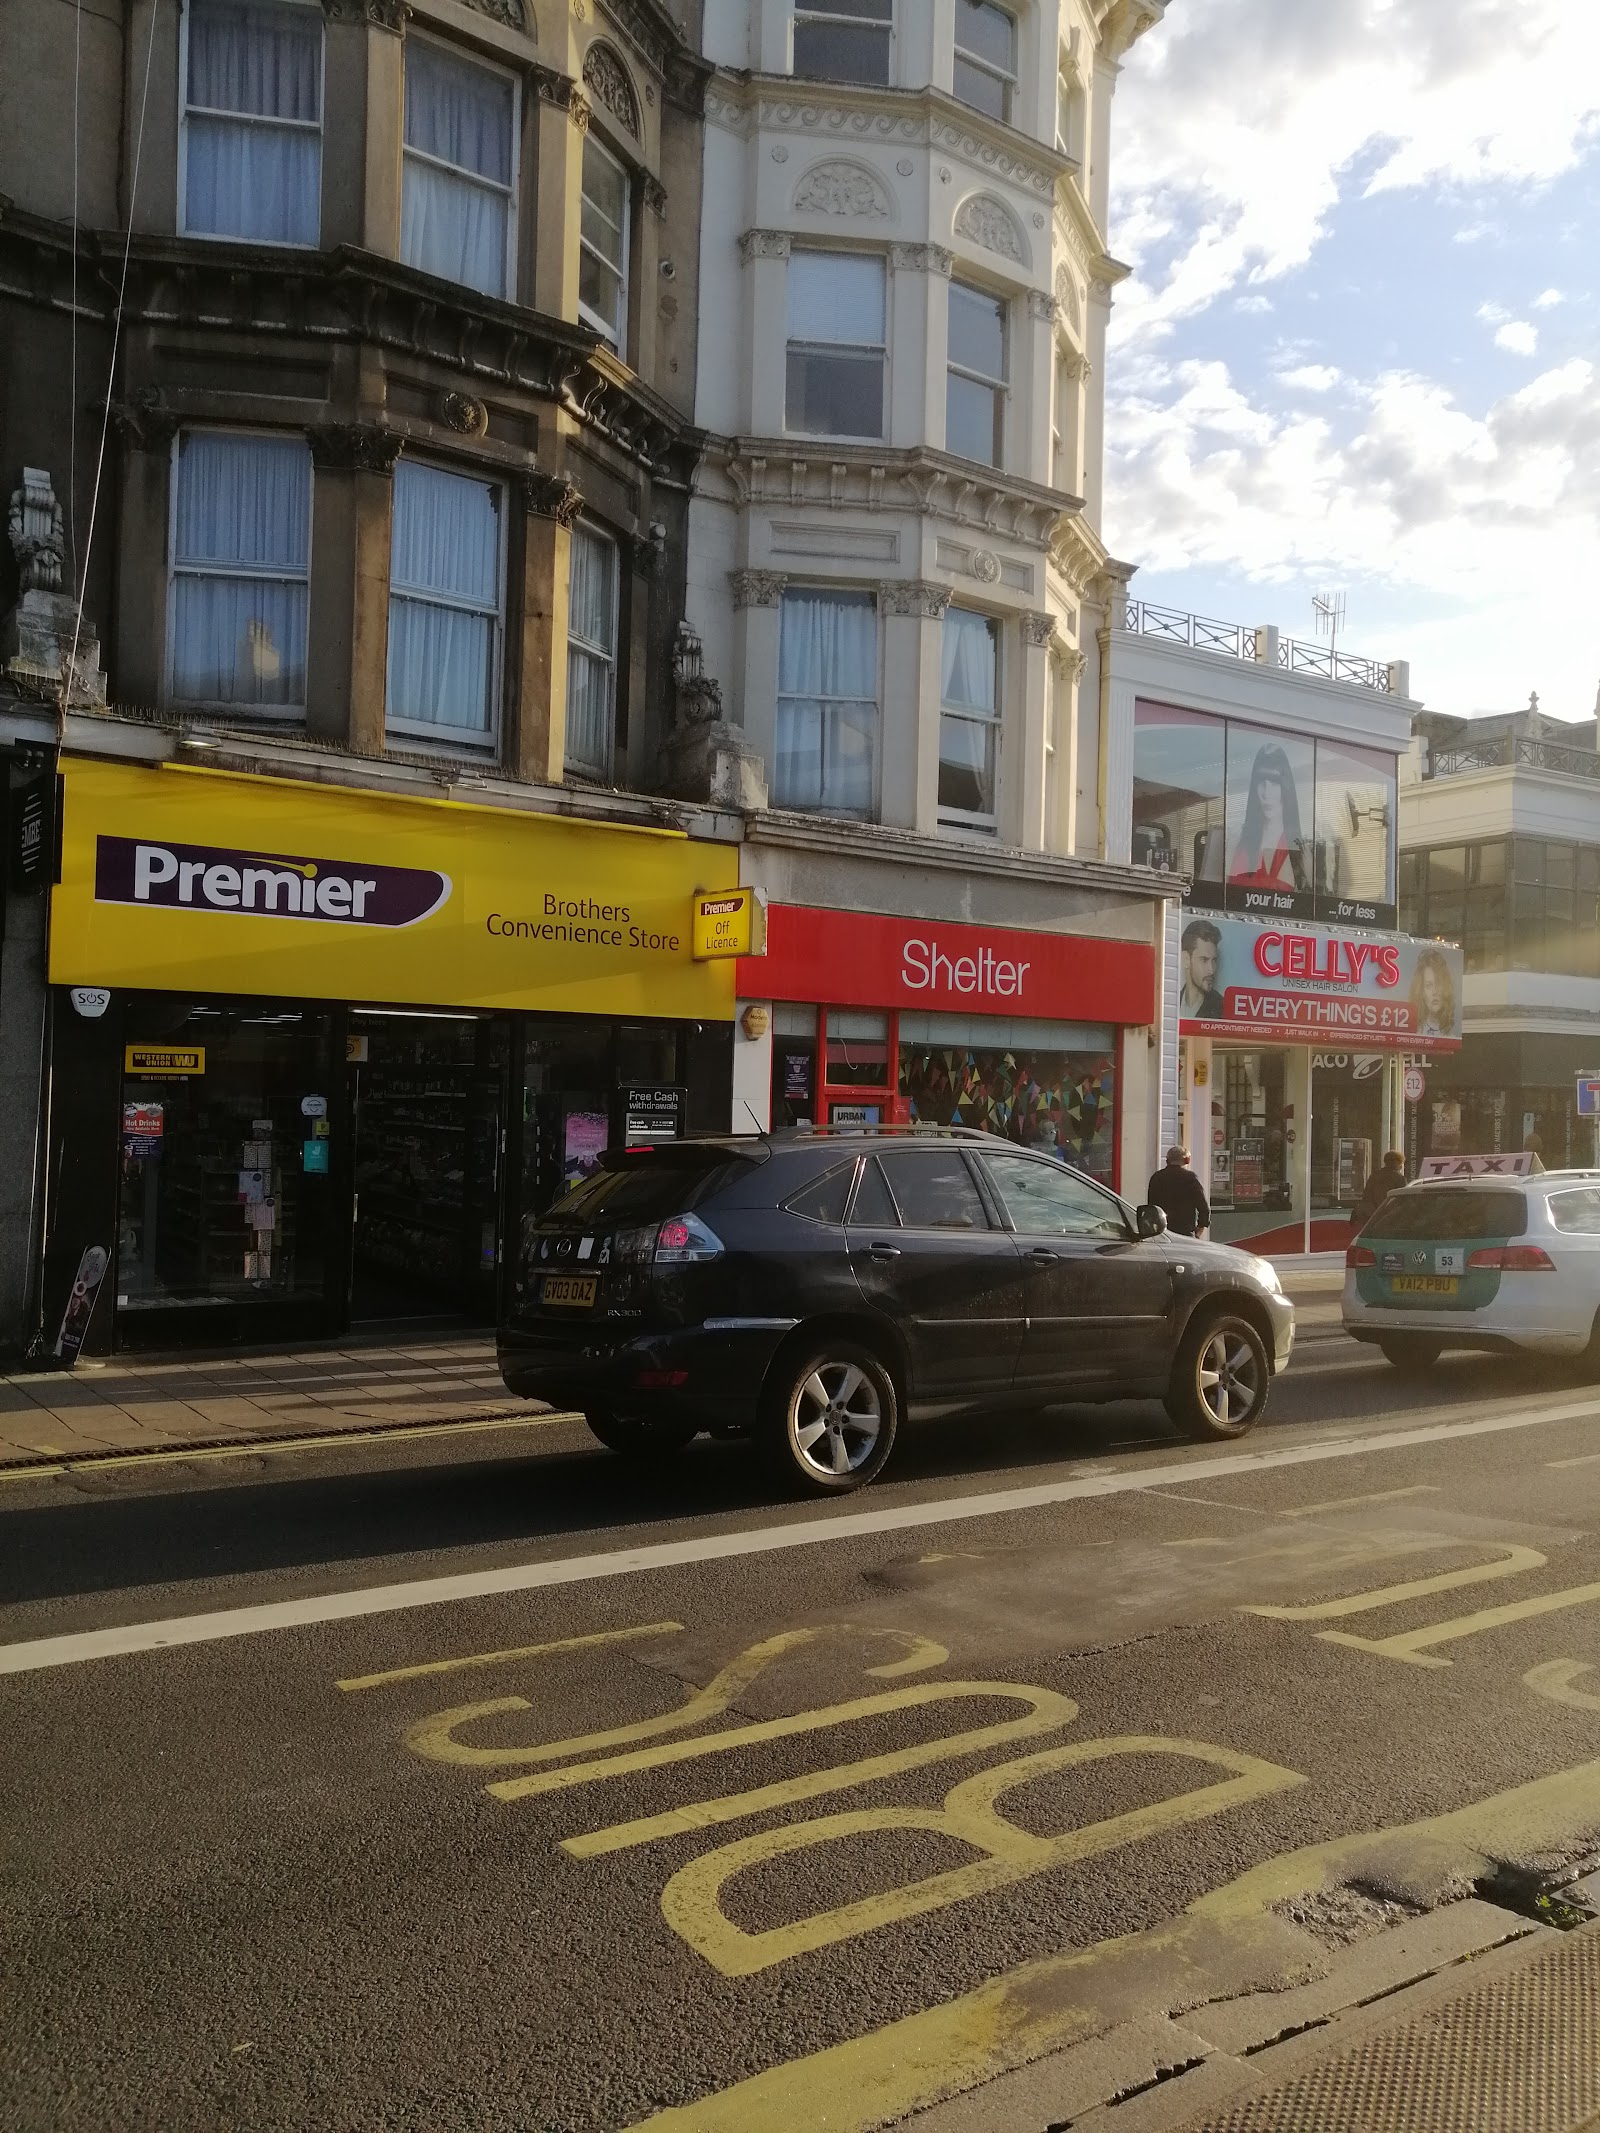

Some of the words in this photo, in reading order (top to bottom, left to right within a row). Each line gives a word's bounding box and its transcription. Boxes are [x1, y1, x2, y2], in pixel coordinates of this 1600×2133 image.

[134, 844, 376, 918] Premier
[543, 893, 631, 924] Brothers
[704, 901, 735, 915] Premier
[1245, 892, 1271, 908] your
[1273, 894, 1295, 910] hair
[1355, 903, 1376, 920] less
[486, 913, 623, 946] Convenience
[628, 925, 680, 952] Store
[715, 920, 730, 935] Off
[706, 936, 738, 949] Licence
[902, 938, 1031, 996] Shelter
[1253, 931, 1400, 988] CELLY'S
[1282, 978, 1311, 989] UNISEX
[1312, 980, 1331, 991] HAIR
[1332, 982, 1359, 993] SALON
[77, 992, 105, 1005] SOS
[1234, 994, 1377, 1027] EVERYTHING'S
[1380, 1007, 1410, 1029] £12
[1210, 1024, 1251, 1033] APPOINTMENT
[1251, 1026, 1272, 1034] NEEDED
[1284, 1028, 1298, 1036] JUST
[1298, 1029, 1312, 1037] WALK
[1329, 1031, 1362, 1040] EXPERIENCED
[1363, 1034, 1386, 1042] STYLISTS
[1410, 1037, 1424, 1045] EVERY
[134, 1053, 171, 1061] WESTERN
[1312, 1053, 1349, 1068] ACO
[1406, 1078, 1420, 1090] £12
[629, 1090, 652, 1101] Free
[654, 1091, 679, 1102] Cash
[629, 1101, 678, 1110] withdrawals
[125, 1119, 138, 1127] Hot
[138, 1119, 161, 1127] Drinks
[837, 1112, 866, 1121] URBAN
[1430, 1158, 1524, 1175] TAXI
[1441, 1256, 1454, 1266] 53
[544, 1280, 569, 1300] GV03
[1399, 1278, 1424, 1291] VA12
[404, 1622, 1308, 1977] BUS
